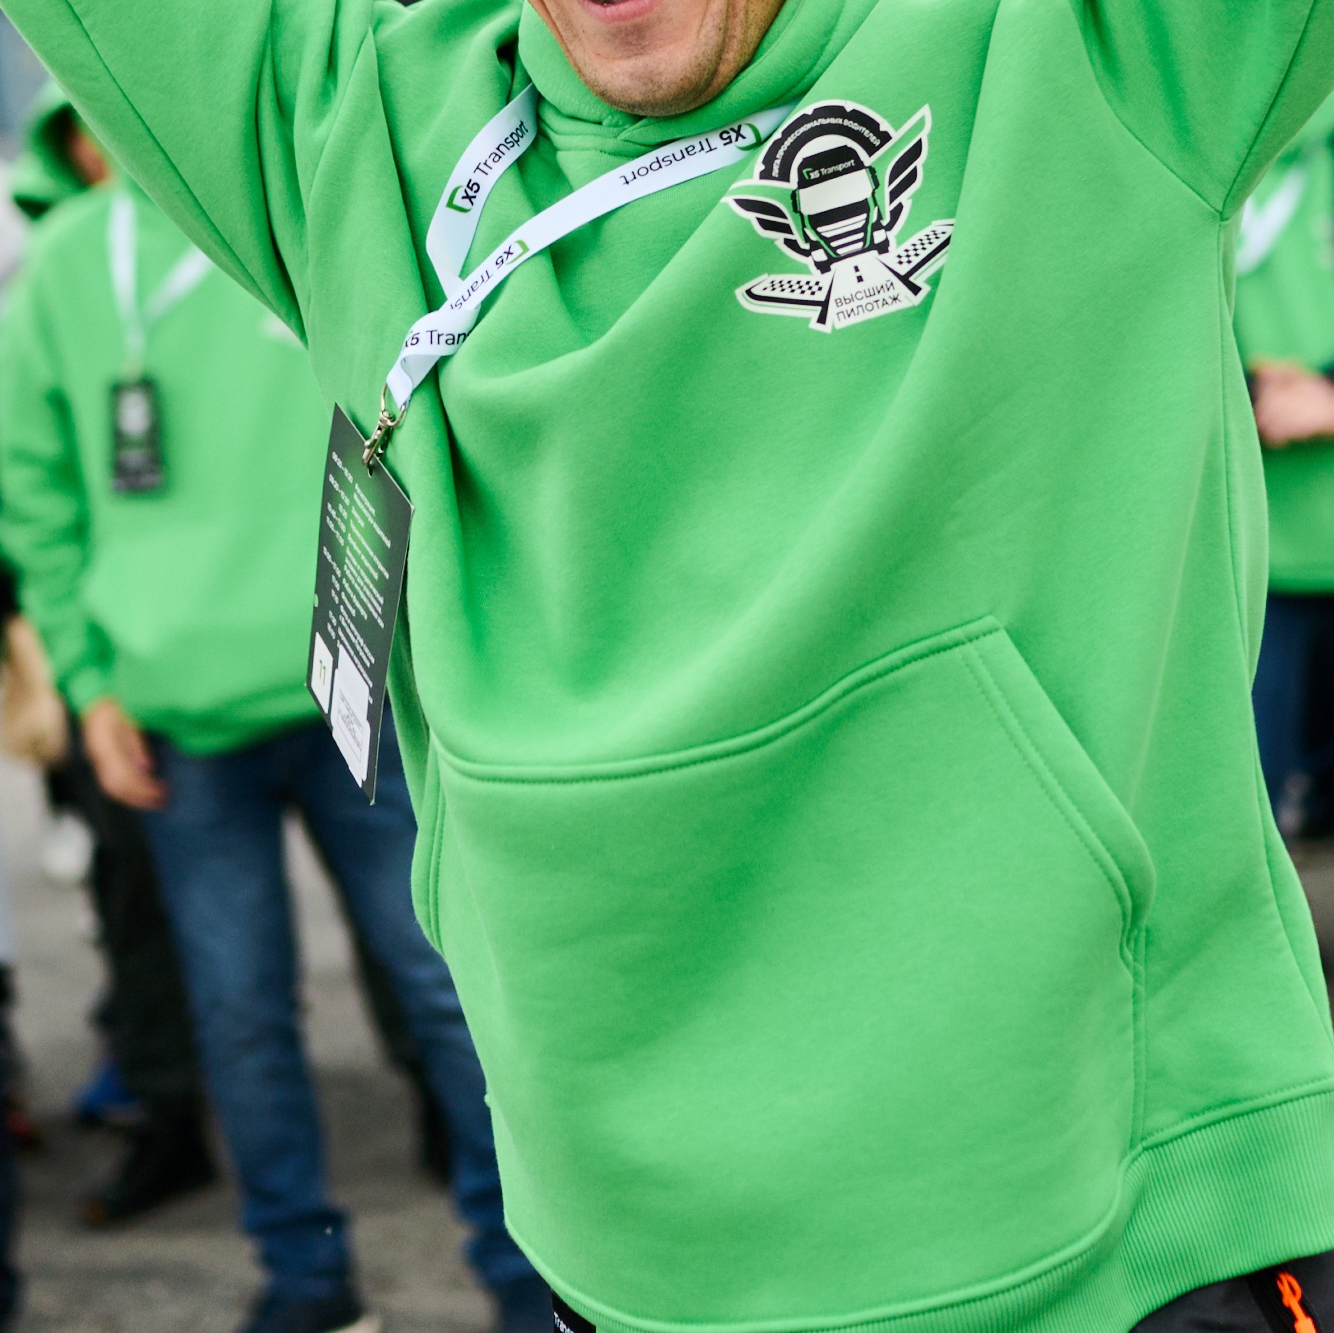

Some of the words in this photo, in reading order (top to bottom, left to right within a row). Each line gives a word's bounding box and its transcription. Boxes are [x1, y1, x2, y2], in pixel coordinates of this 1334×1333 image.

[473, 120, 529, 176] Transport
[619, 137, 718, 185] Transport
[820, 159, 855, 176] Transport
[450, 270, 494, 310] Trans
[834, 279, 895, 308] ВЫСШИЙ
[836, 293, 902, 322] ПИЛОТАЖ
